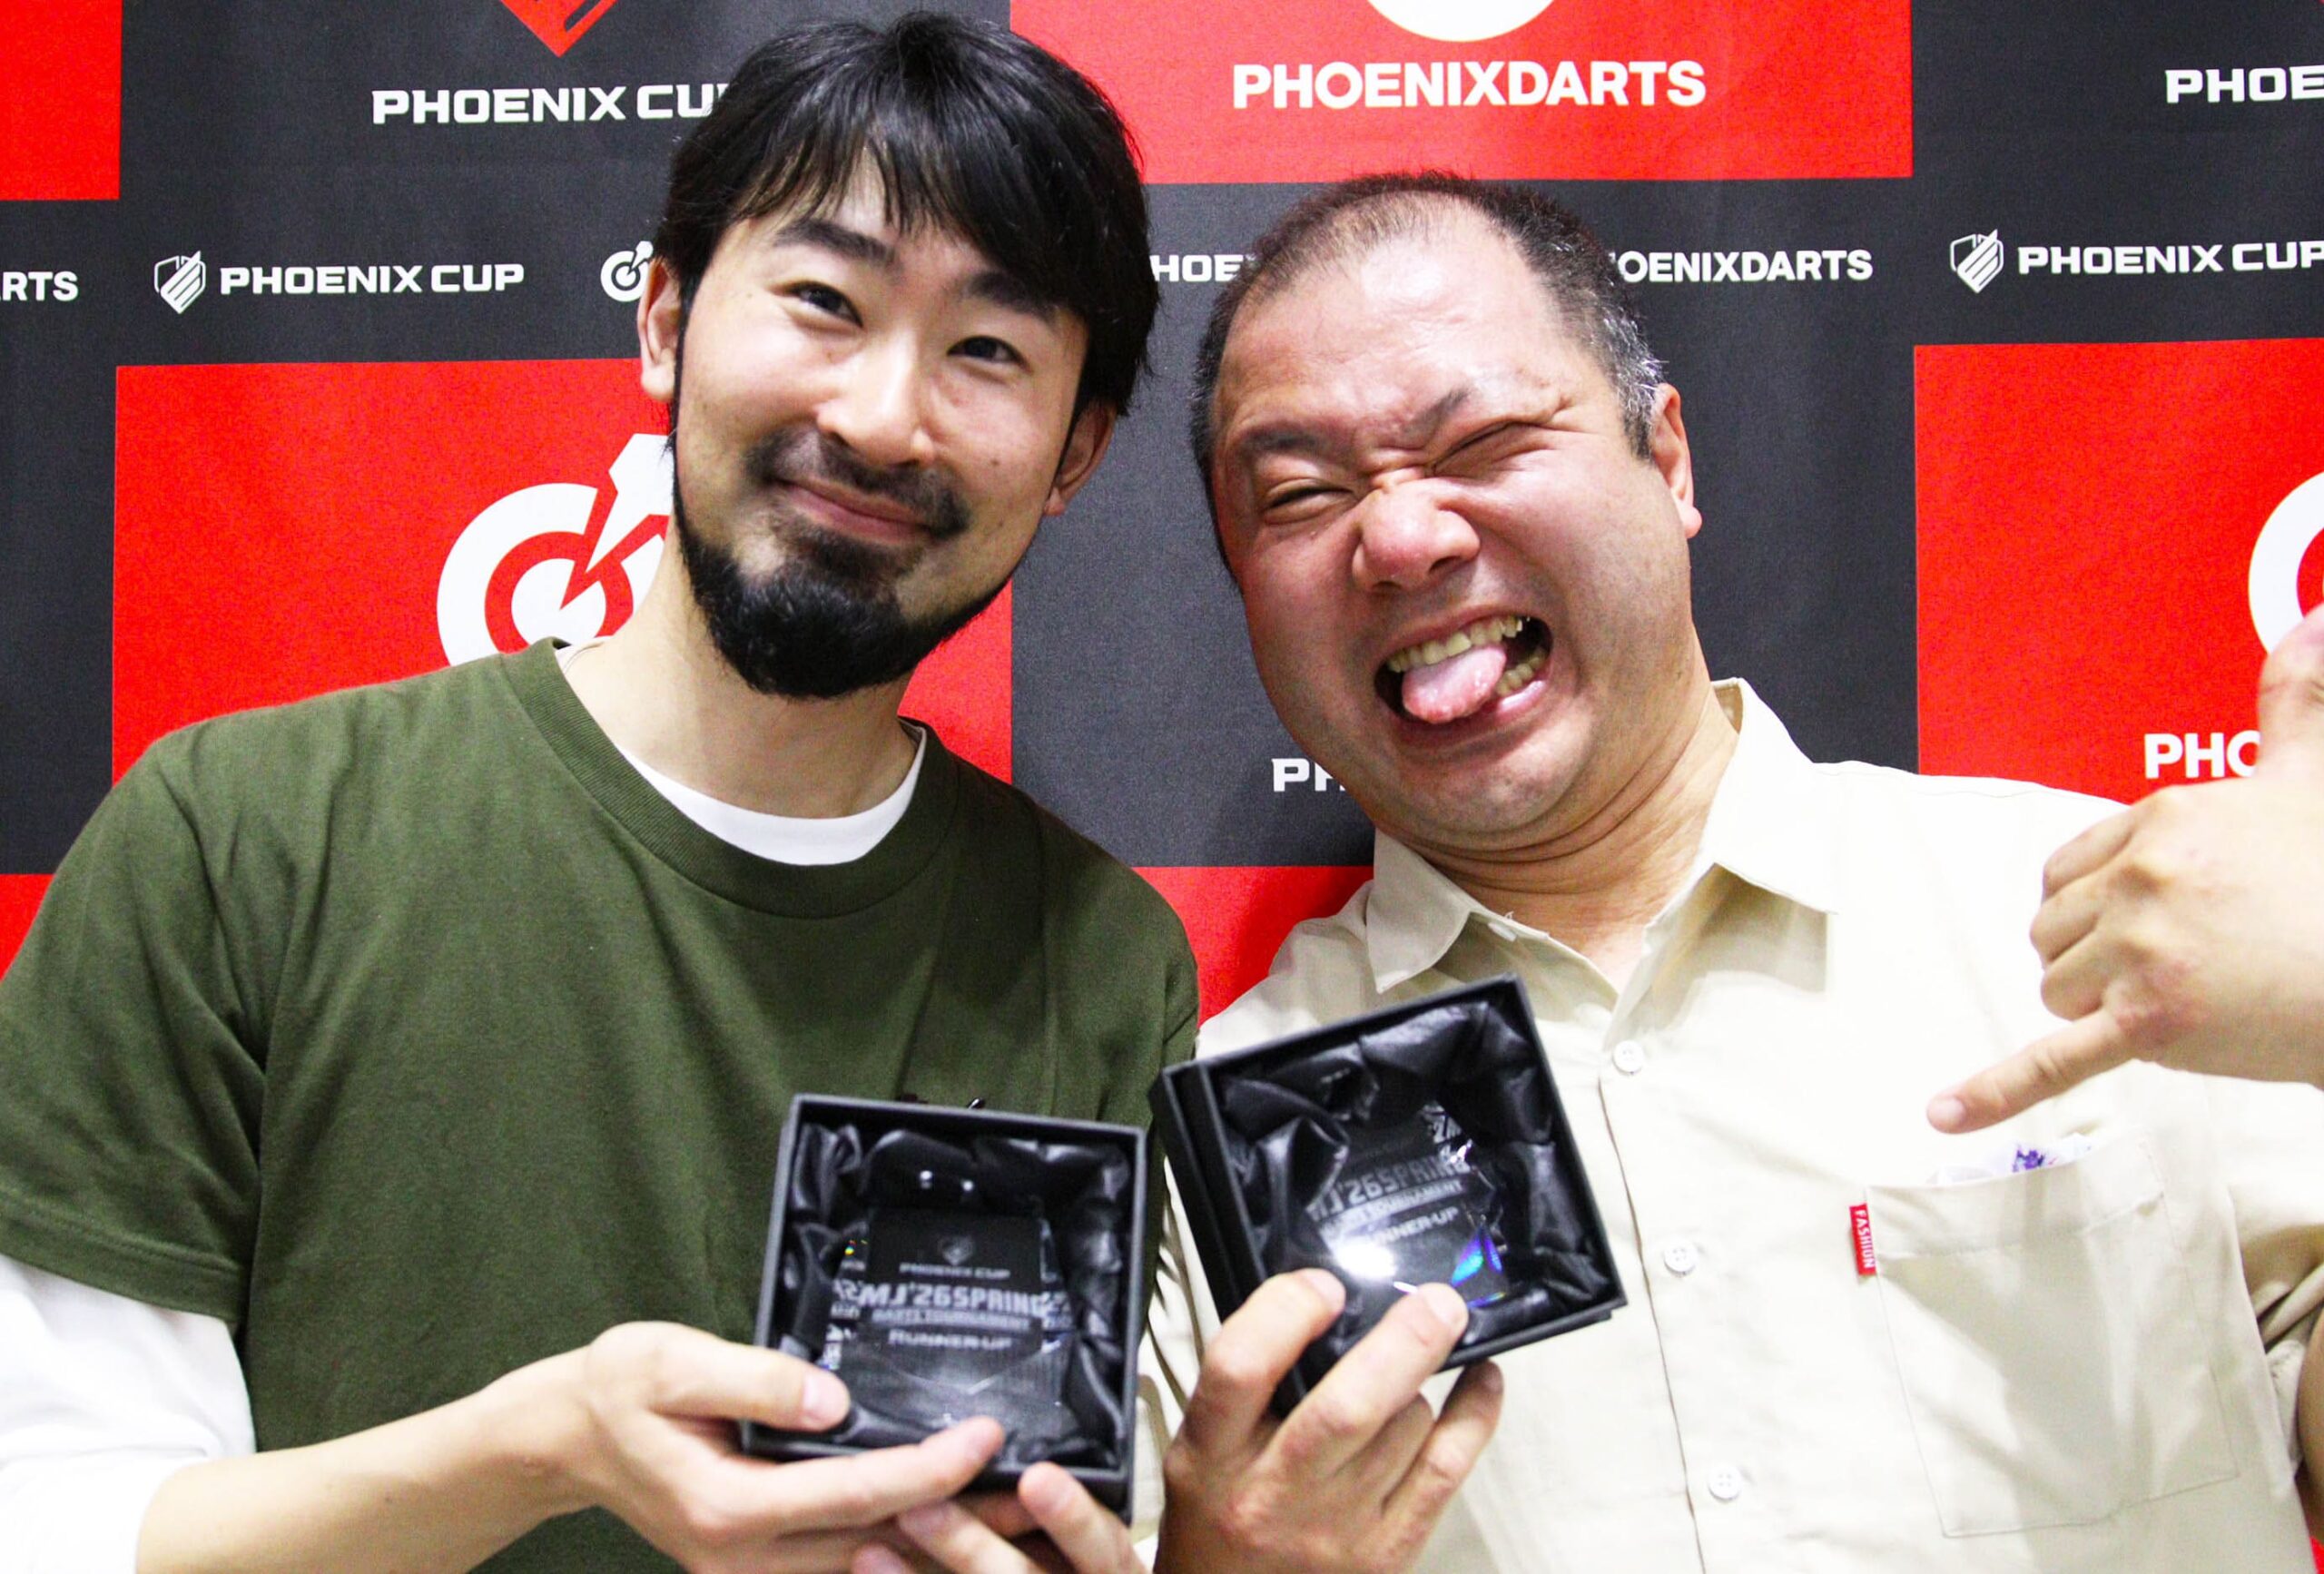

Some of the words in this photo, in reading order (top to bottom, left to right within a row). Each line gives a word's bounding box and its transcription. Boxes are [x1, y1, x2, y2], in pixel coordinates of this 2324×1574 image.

[1233, 60, 1707, 109] PHOENIXDARTS
[2165, 64, 2324, 103] PHOE
[372, 86, 626, 124] PHOENIX
[636, 83, 729, 120] CU
[1149, 253, 1256, 283] HOE
[1609, 250, 1874, 283] OENIXDARTS
[2017, 244, 2223, 275] PHOENIX
[2231, 240, 2324, 271] CUP
[0, 271, 79, 301] RTS
[220, 265, 423, 295] PHOENIX
[430, 263, 525, 293] CUP
